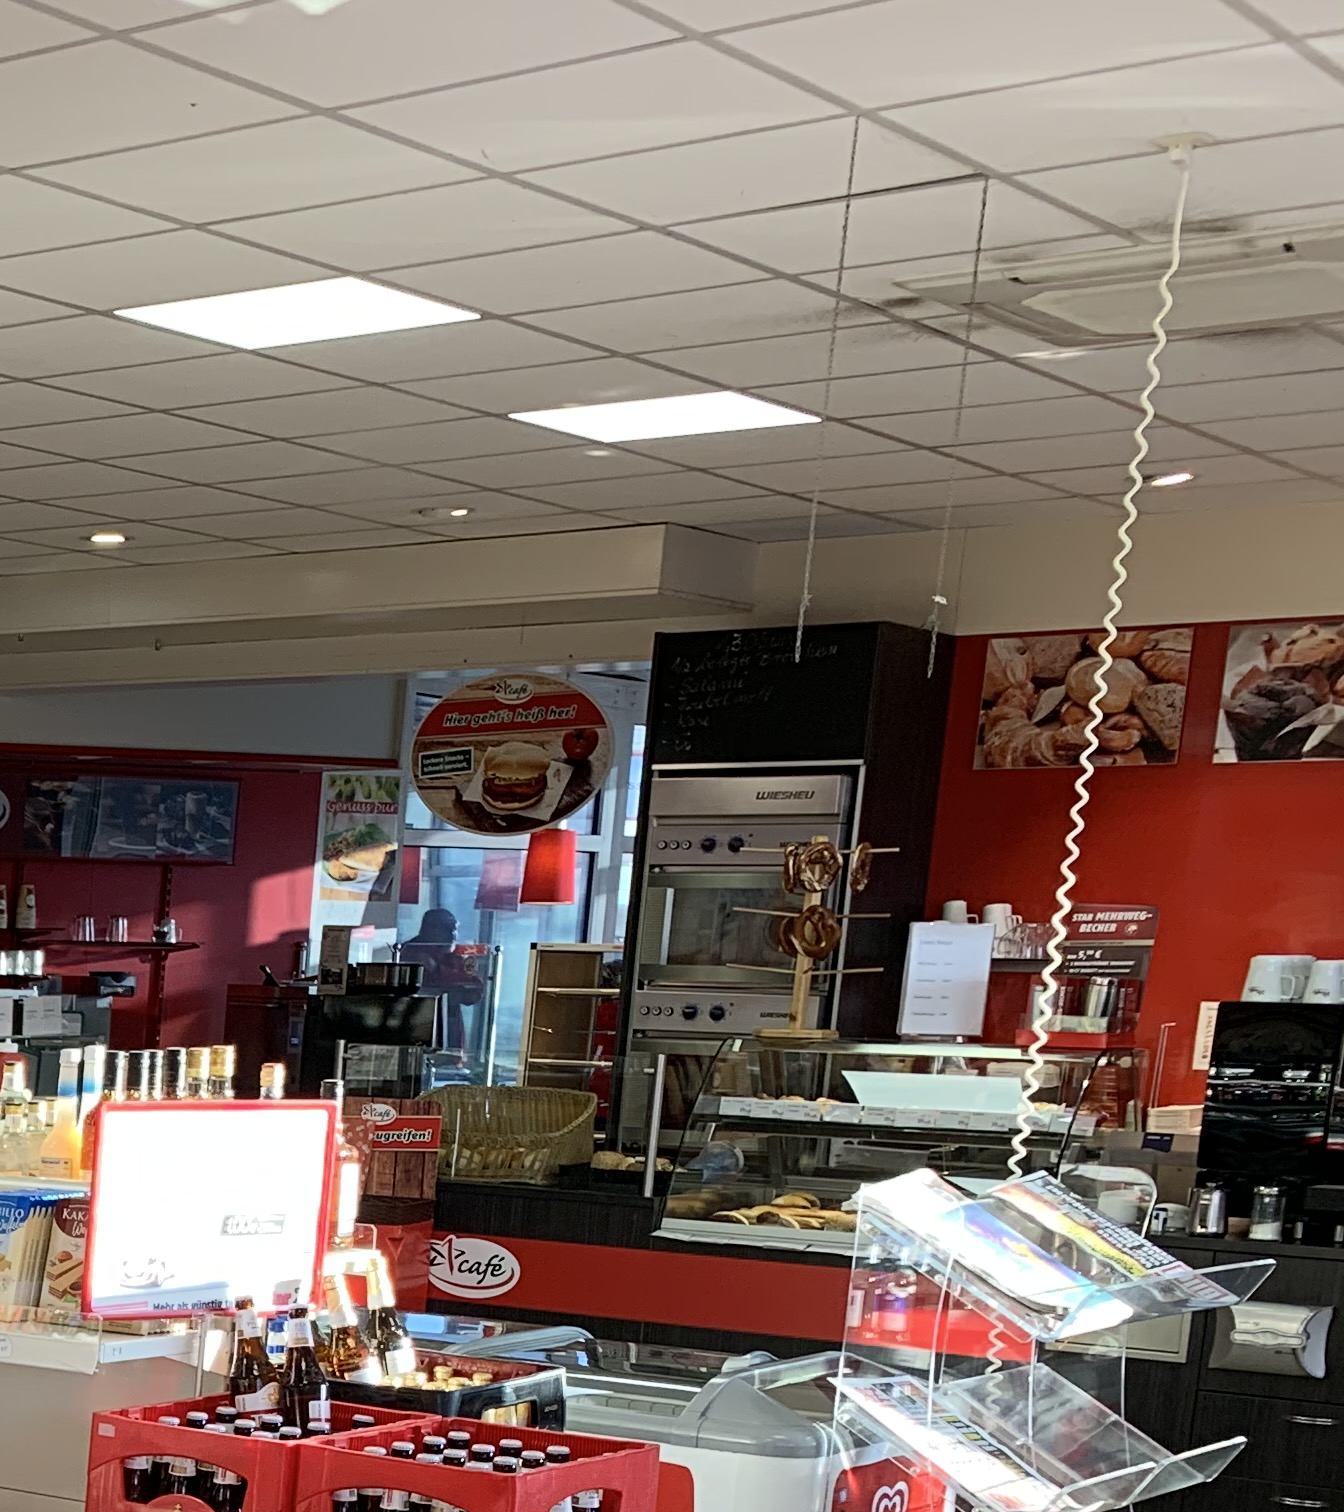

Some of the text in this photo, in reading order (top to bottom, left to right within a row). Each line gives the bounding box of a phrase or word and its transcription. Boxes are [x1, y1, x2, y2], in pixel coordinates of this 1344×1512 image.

[443, 705, 577, 727] Hier geht's heiß her!
[755, 790, 815, 800] WIESHEU
[1072, 911, 1153, 922] STAR MEHRWEG-
[1079, 923, 1117, 933] BECHER
[374, 1129, 432, 1145] ugreifen!
[457, 1251, 507, 1285] café
